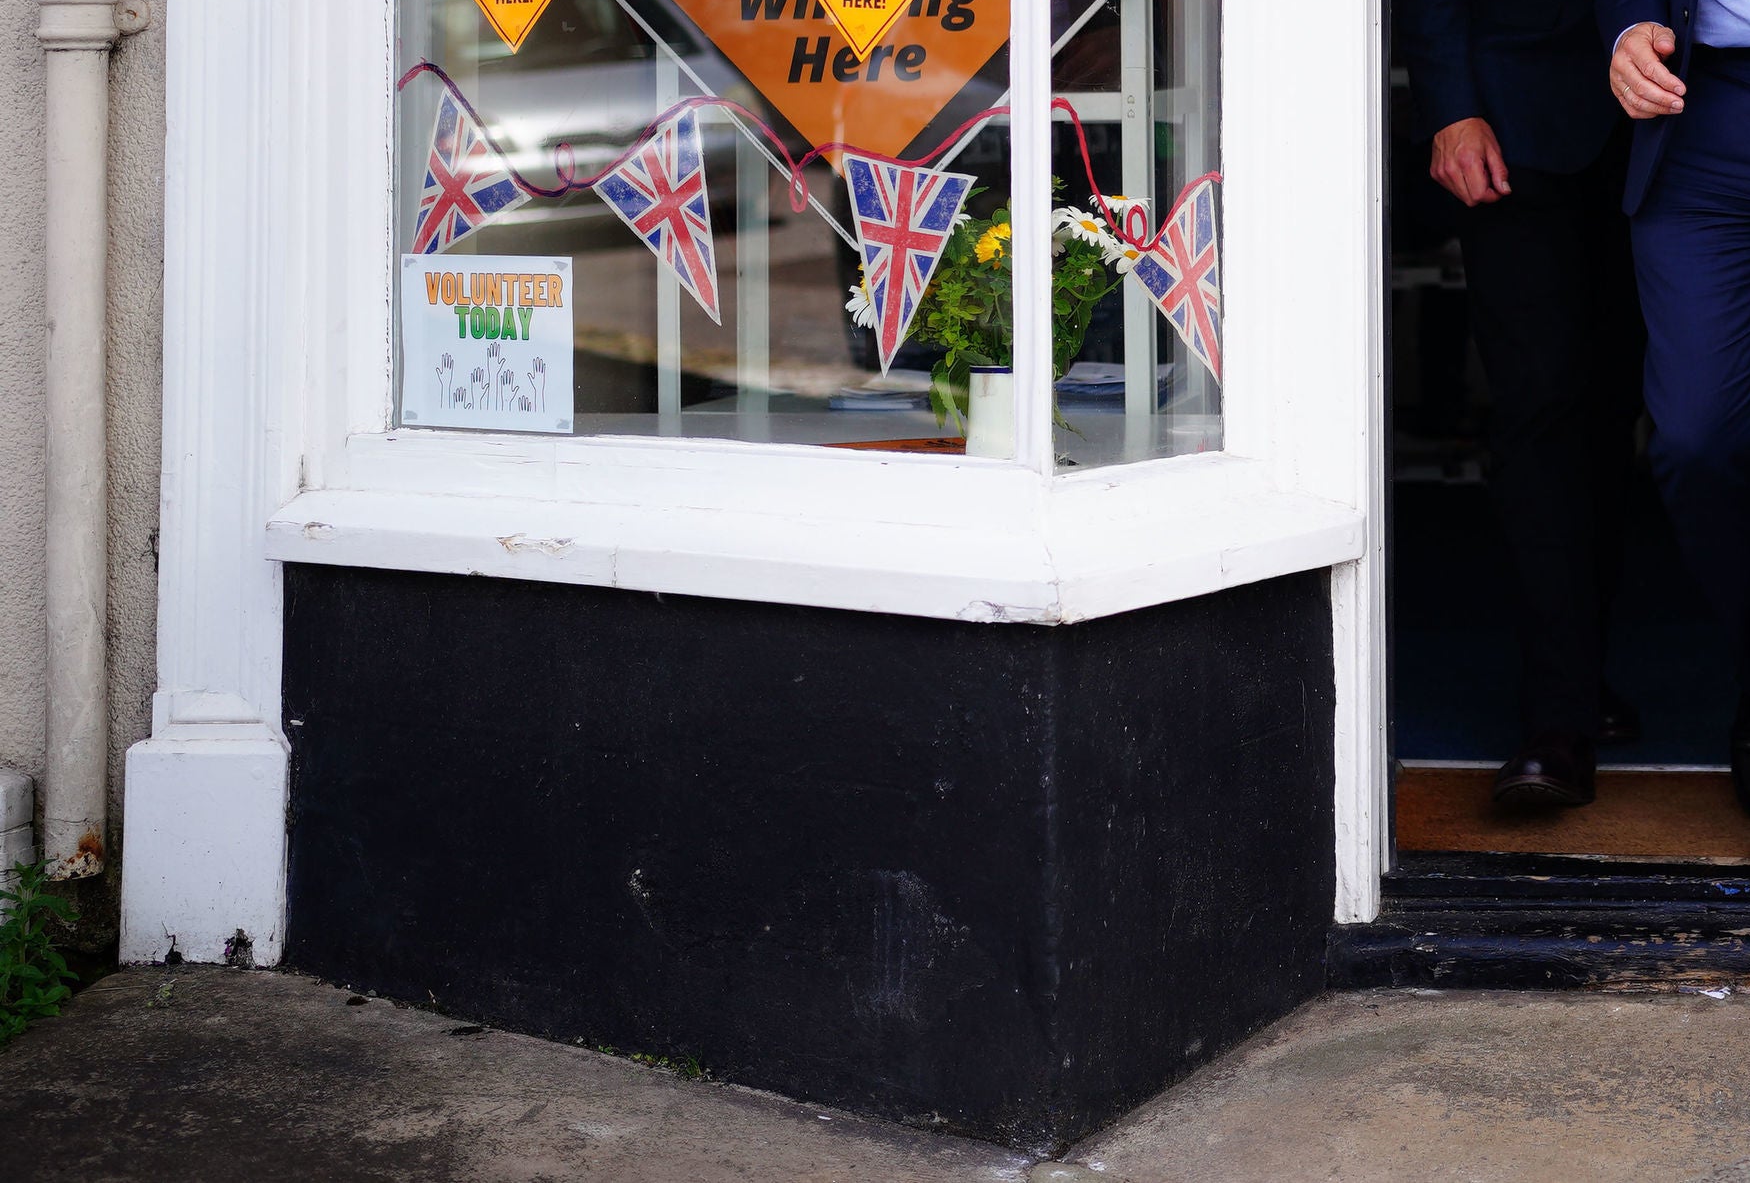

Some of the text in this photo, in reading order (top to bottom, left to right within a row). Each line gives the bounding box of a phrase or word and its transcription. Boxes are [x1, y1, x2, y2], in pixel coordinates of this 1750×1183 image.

[787, 36, 927, 84] Here
[425, 272, 563, 308] VOLUNTEER
[454, 305, 533, 341] TODAY
